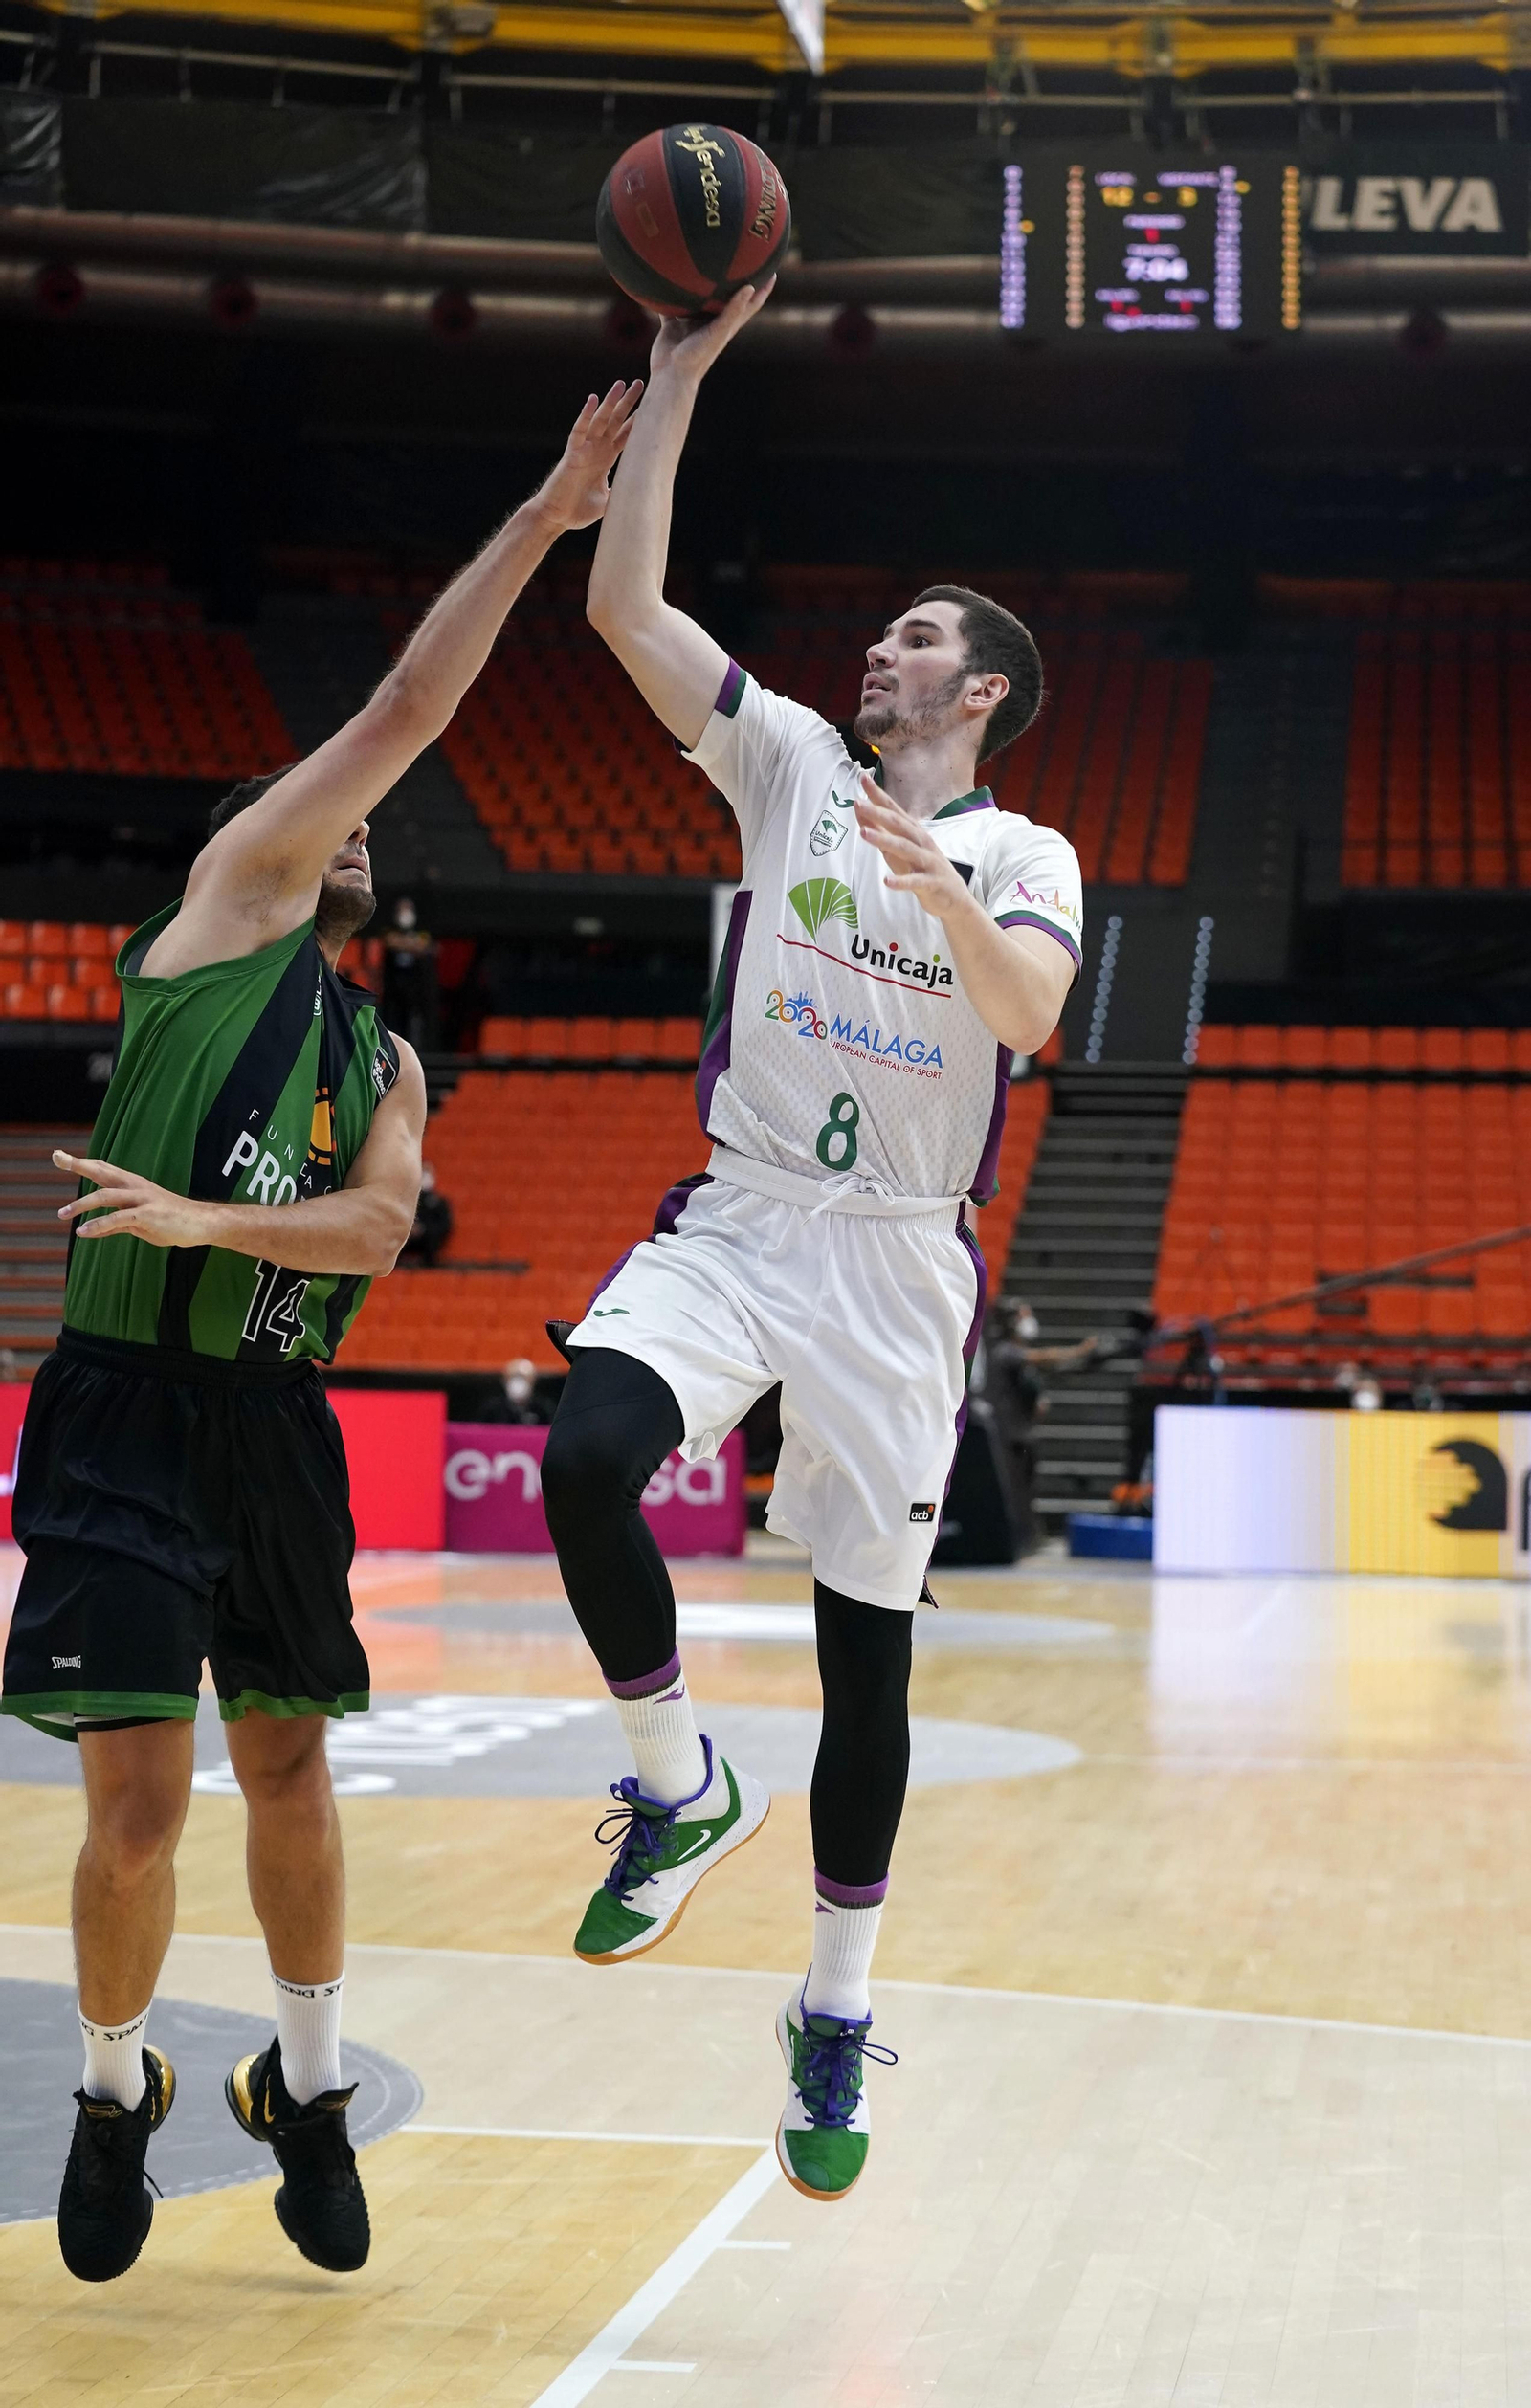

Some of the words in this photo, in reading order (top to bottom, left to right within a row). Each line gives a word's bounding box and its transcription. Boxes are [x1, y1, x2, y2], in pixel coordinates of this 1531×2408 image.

[1302, 176, 1504, 232] LEVA
[851, 934, 953, 988] Unicaja
[765, 989, 828, 1040] 2020
[830, 1013, 943, 1069] MÁLAGA
[869, 1055, 900, 1071] CAPITAL
[902, 1065, 916, 1077] OF
[916, 1068, 943, 1080] SPORT
[816, 1092, 859, 1171] 8
[221, 1130, 306, 1206] PRO
[242, 1258, 310, 1352] 14
[445, 1449, 727, 1506] ensa
[911, 1511, 929, 1520] acb
[51, 1655, 81, 1669] SPALDING
